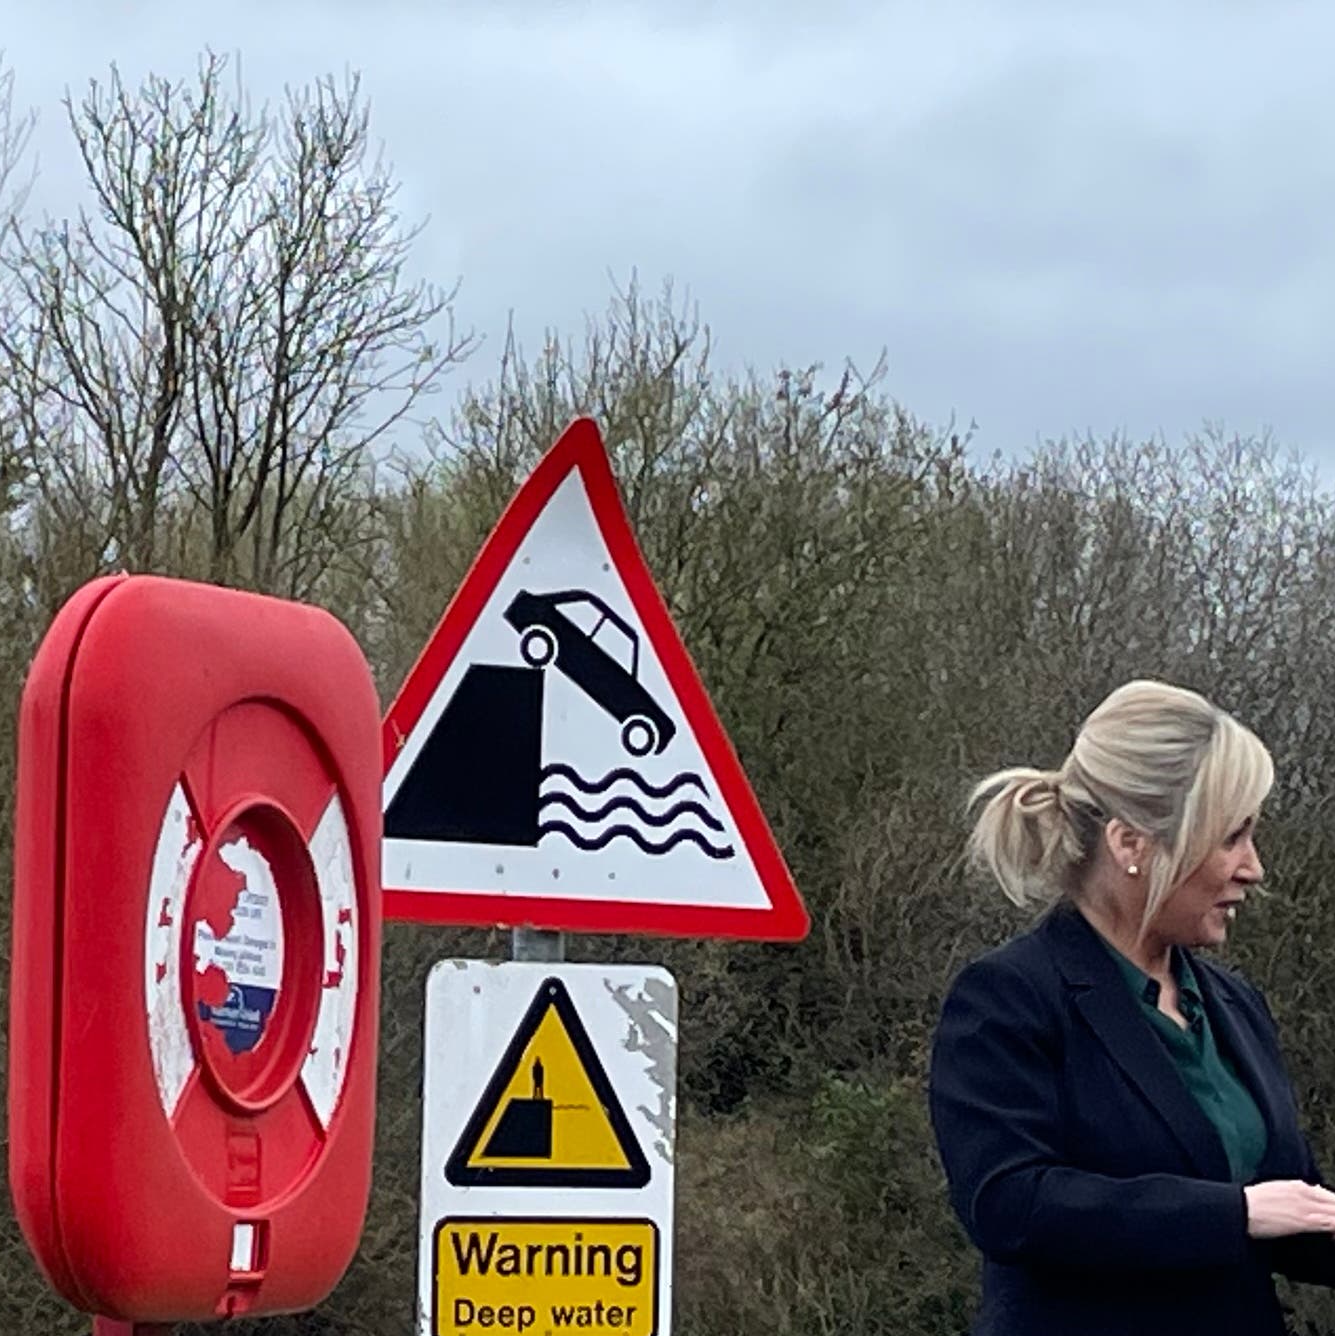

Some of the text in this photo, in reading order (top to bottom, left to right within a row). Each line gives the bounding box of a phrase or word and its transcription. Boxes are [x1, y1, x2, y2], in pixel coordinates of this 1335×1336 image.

[451, 1232, 643, 1288] Warning
[454, 1299, 637, 1332] Deep water
